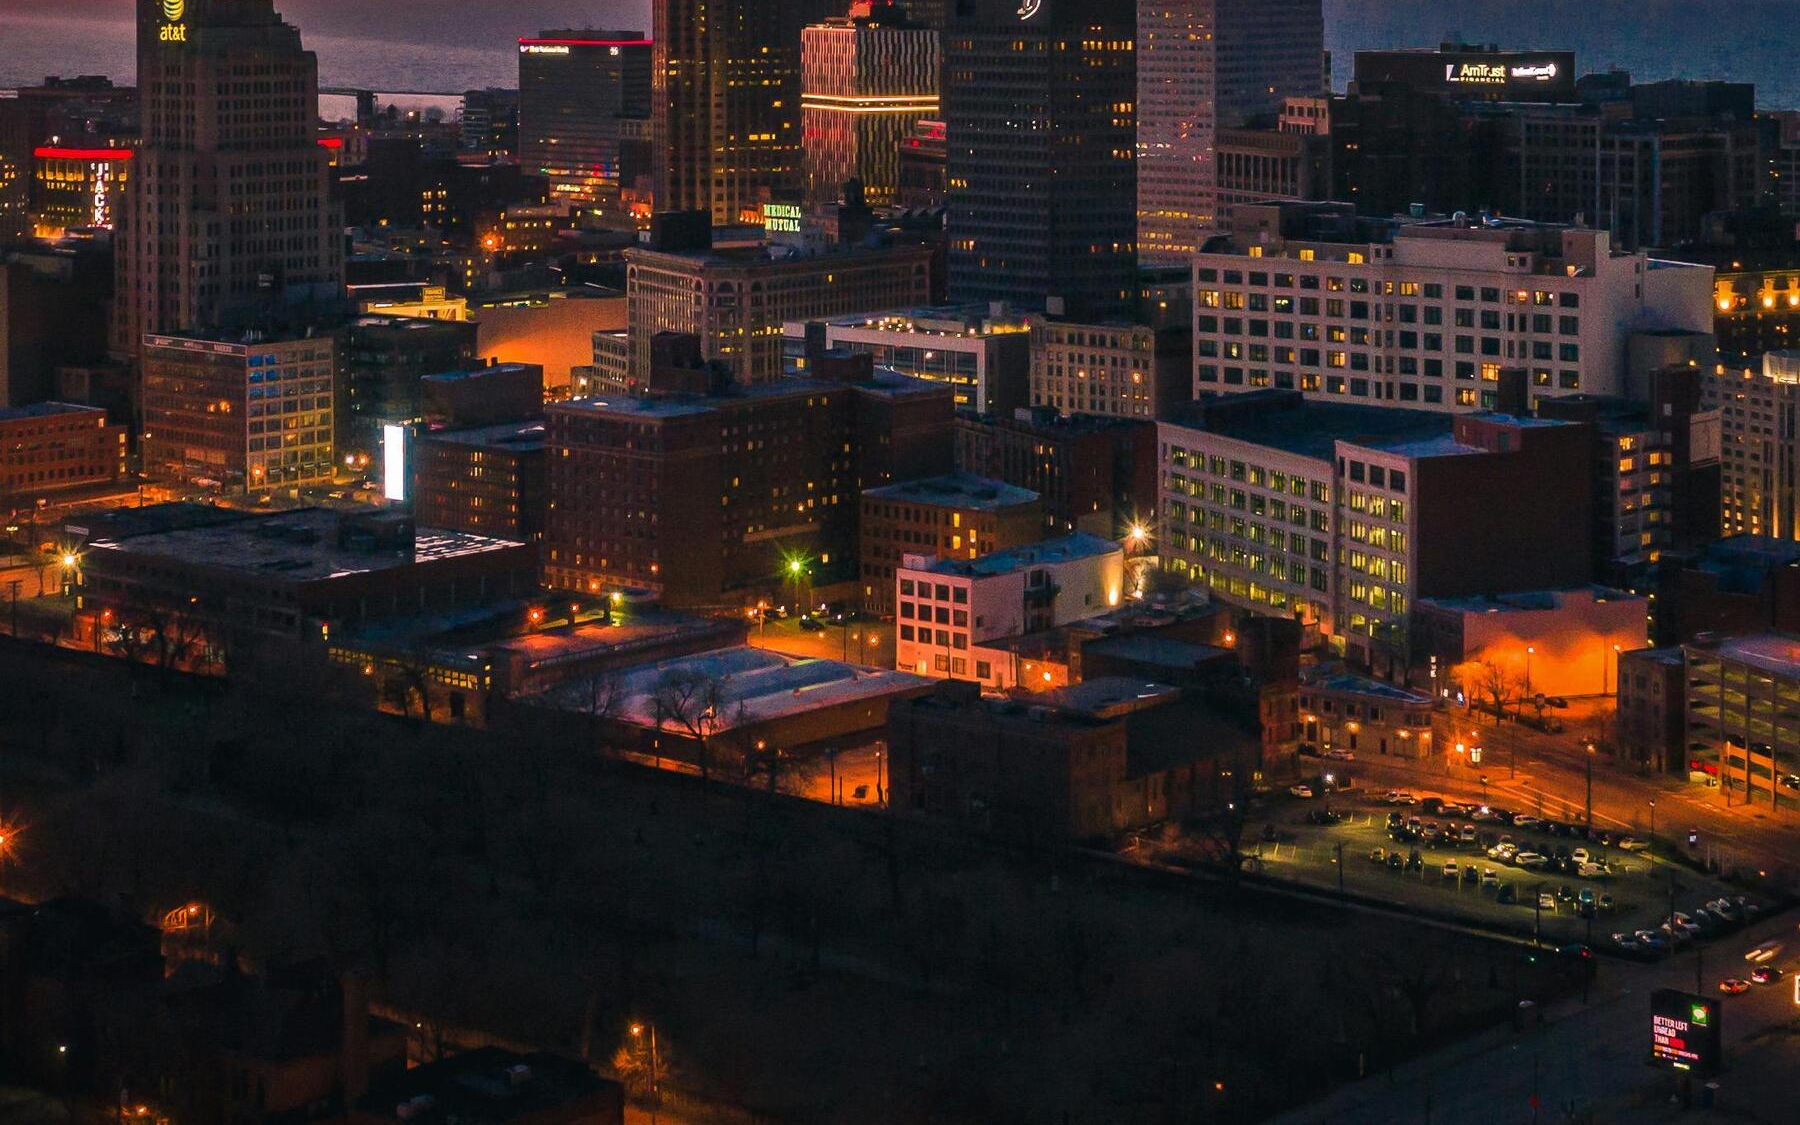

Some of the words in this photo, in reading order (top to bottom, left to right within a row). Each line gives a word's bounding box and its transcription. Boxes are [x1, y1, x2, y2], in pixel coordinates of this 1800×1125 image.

[160, 23, 186, 42] at&t
[1460, 63, 1506, 77] AmTrust
[95, 163, 105, 222] JACK
[763, 204, 802, 218] MEDICAL
[765, 217, 801, 232] MUTUAL
